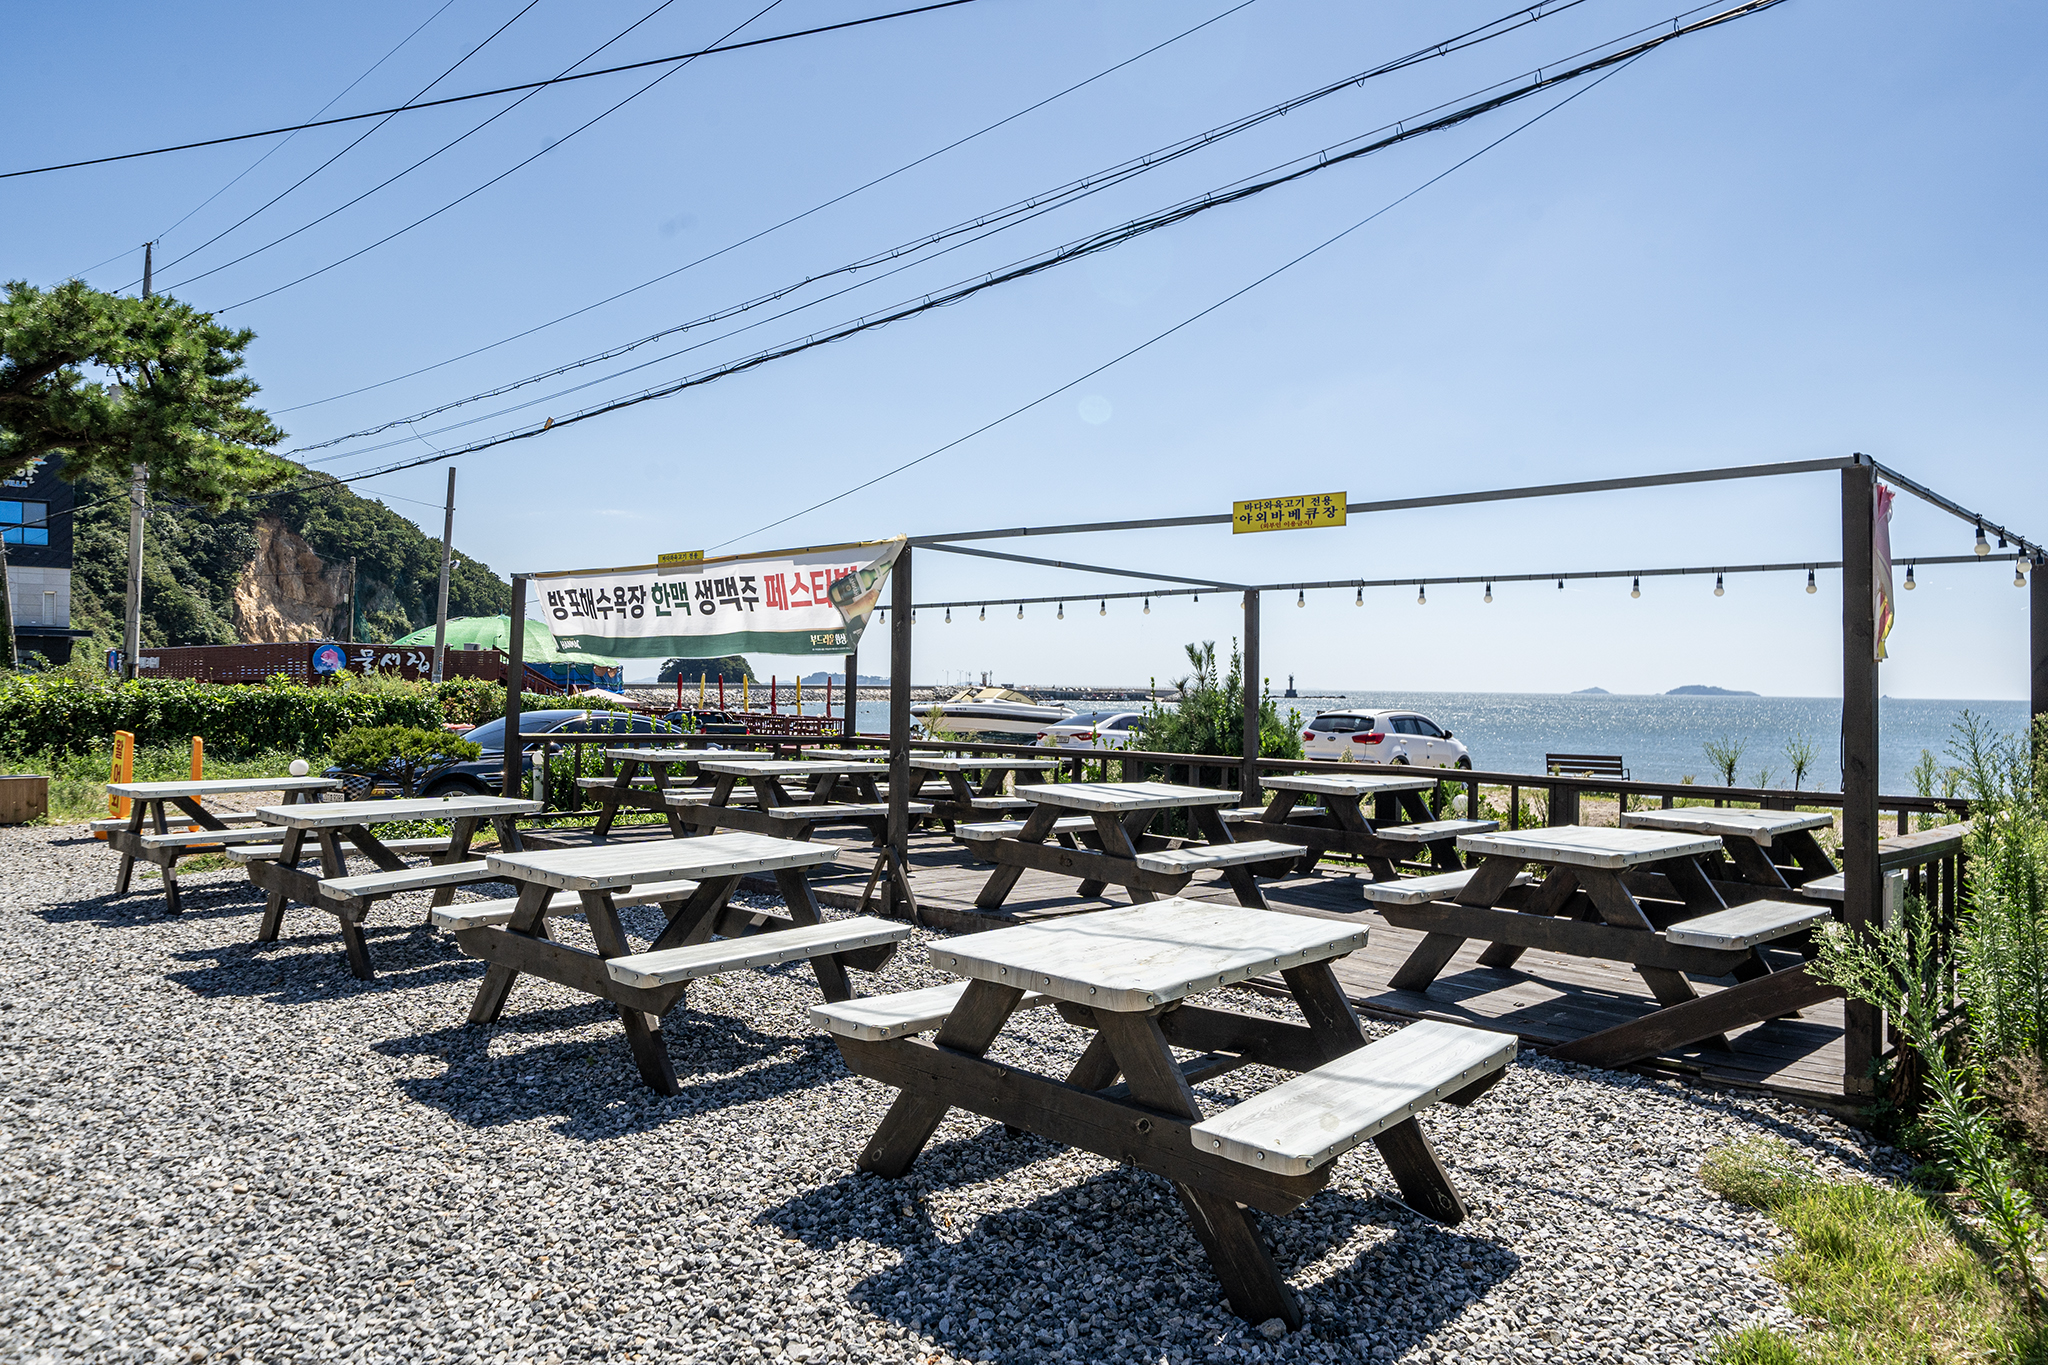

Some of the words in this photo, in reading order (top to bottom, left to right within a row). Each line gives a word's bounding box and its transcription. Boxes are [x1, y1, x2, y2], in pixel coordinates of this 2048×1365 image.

[2, 479, 28, 488] VILLA
[1244, 498, 1305, 512] 바다와육고기
[1311, 495, 1333, 507] 전용
[1239, 505, 1338, 525] 야외바베큐장
[547, 585, 646, 620] 방포해수욕장
[651, 582, 692, 616] 한맥
[695, 576, 759, 615] 생맥주
[810, 634, 834, 646] 부드러운
